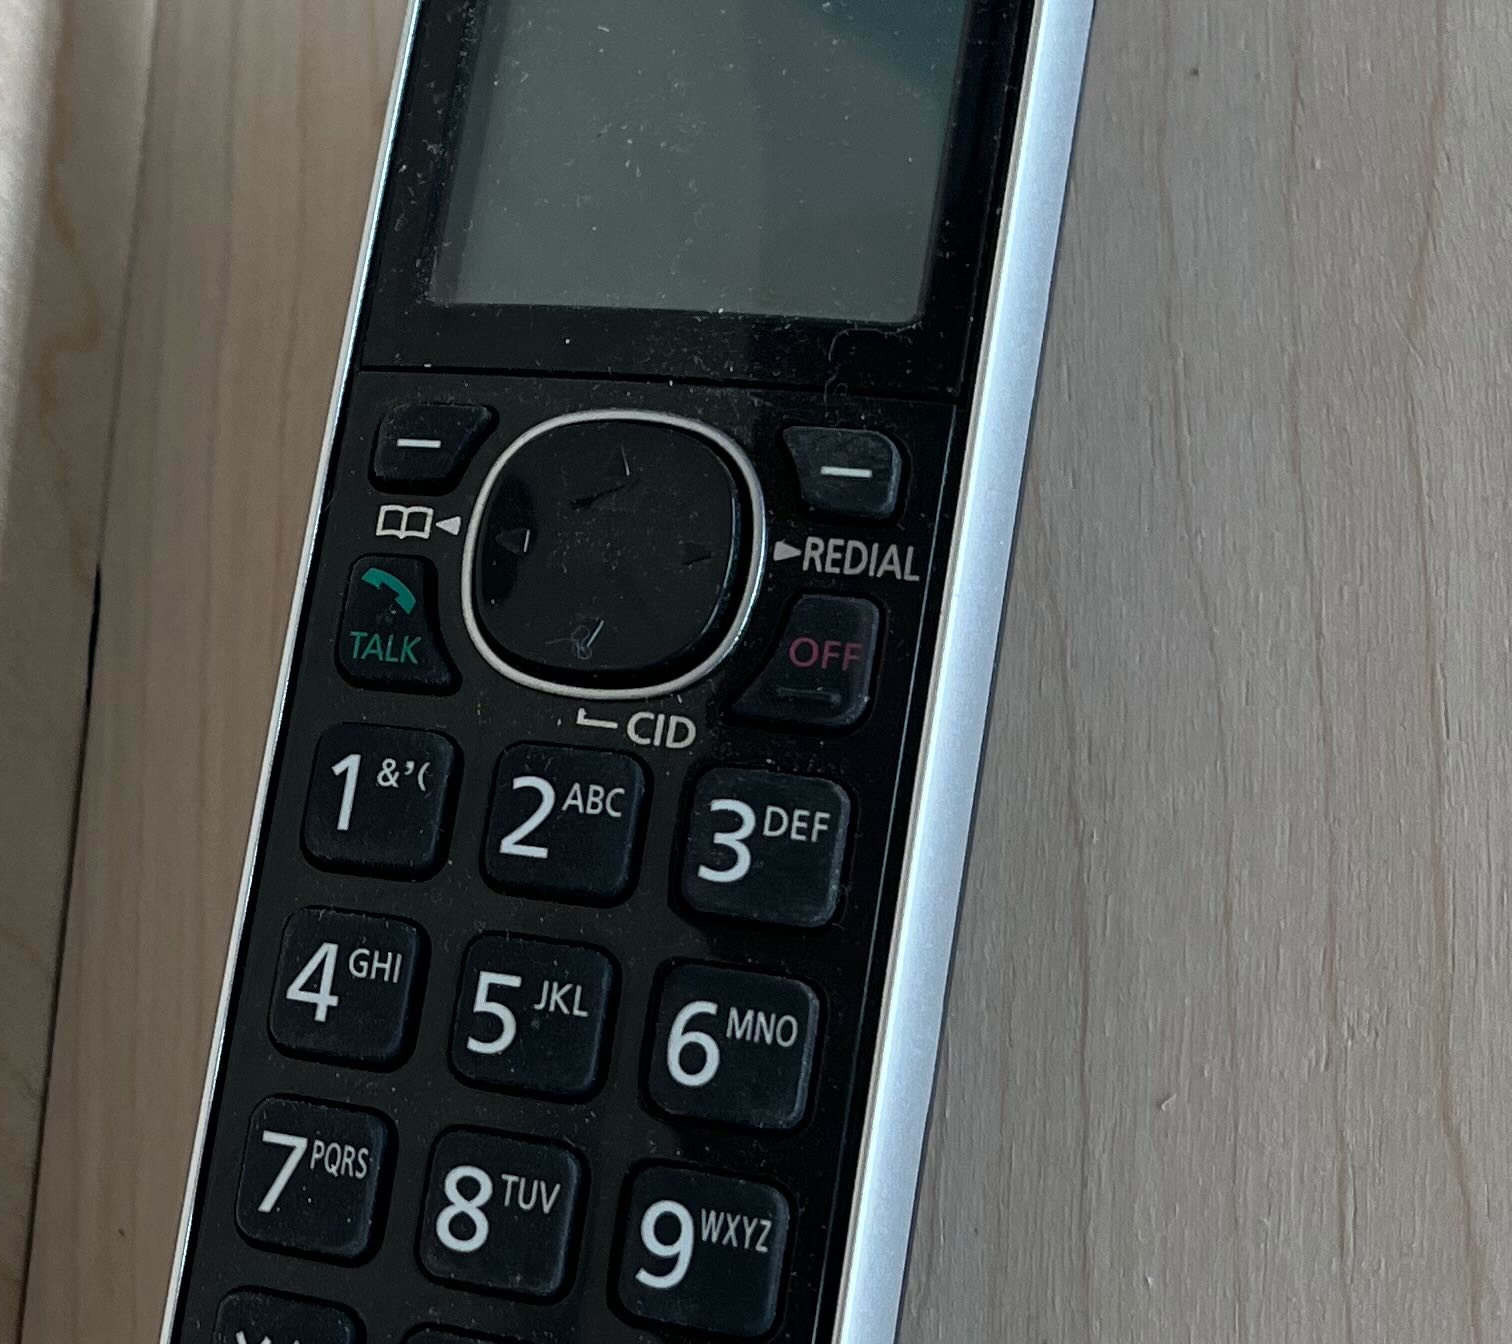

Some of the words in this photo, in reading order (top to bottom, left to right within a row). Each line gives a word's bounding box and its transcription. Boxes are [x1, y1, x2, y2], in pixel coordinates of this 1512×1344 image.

[802, 537, 920, 582] REDIAL
[349, 631, 422, 665] TALK
[789, 638, 862, 672] OFF
[626, 712, 697, 748] CID
[331, 753, 361, 831] 1
[499, 775, 556, 858] 2
[561, 784, 625, 818] ABC
[697, 799, 756, 884] 3
[762, 808, 830, 843] DEF
[285, 941, 339, 1023] 4
[348, 948, 402, 983] GHI
[466, 970, 522, 1055] 5
[533, 980, 589, 1017] JKL
[666, 1000, 720, 1087] 6
[725, 1007, 798, 1048] MNO
[256, 1130, 308, 1213] 7
[310, 1139, 369, 1179] PQRS
[435, 1165, 492, 1253] 8
[501, 1174, 561, 1215] TUV
[635, 1199, 694, 1289] 9
[699, 1208, 773, 1253] WXYZ
